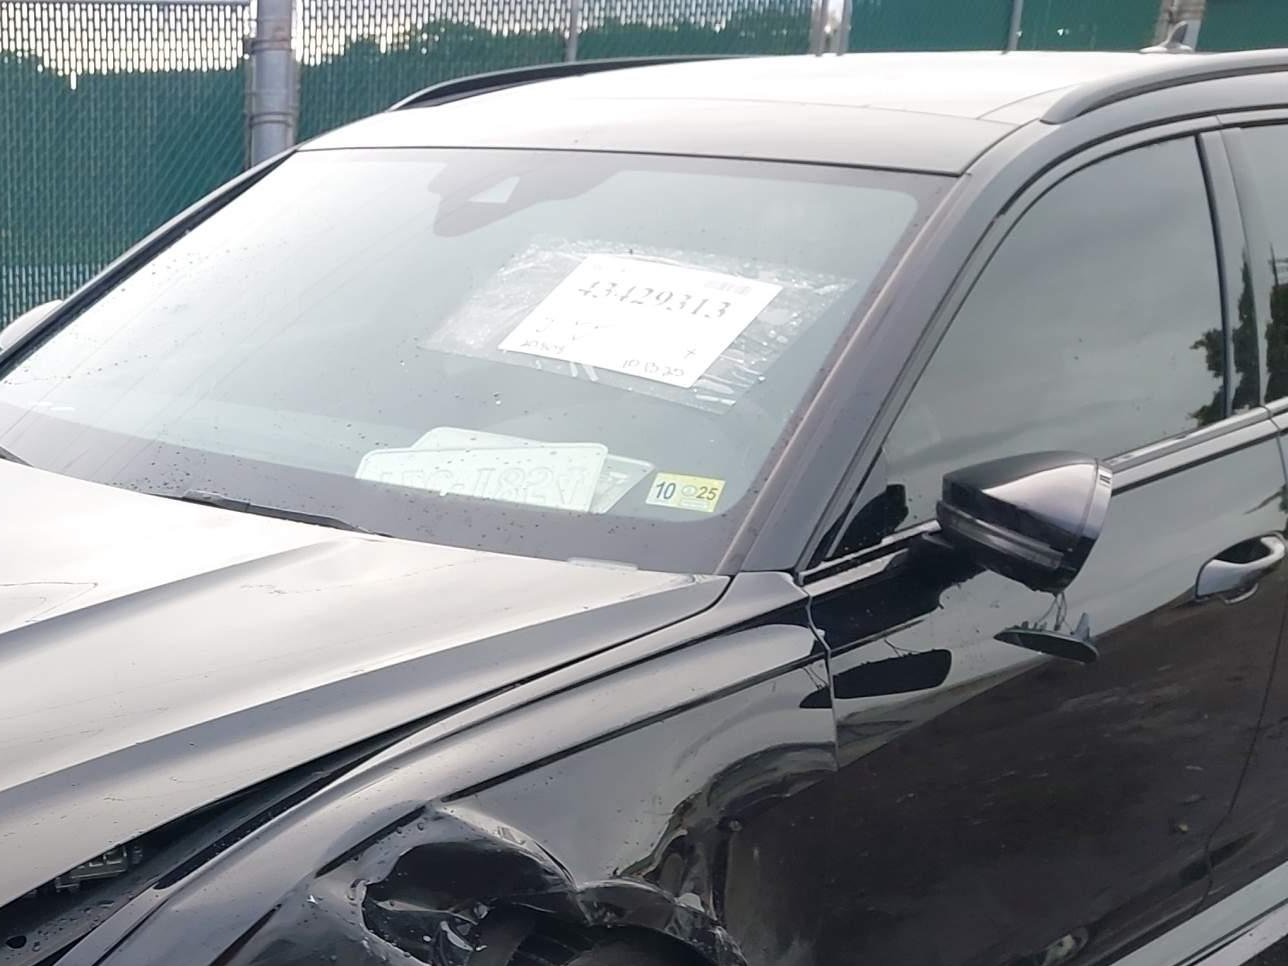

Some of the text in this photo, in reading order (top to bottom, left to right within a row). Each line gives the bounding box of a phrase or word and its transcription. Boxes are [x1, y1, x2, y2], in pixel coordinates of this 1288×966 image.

[578, 279, 732, 319] 43429313
[656, 481, 719, 501] 10 25
